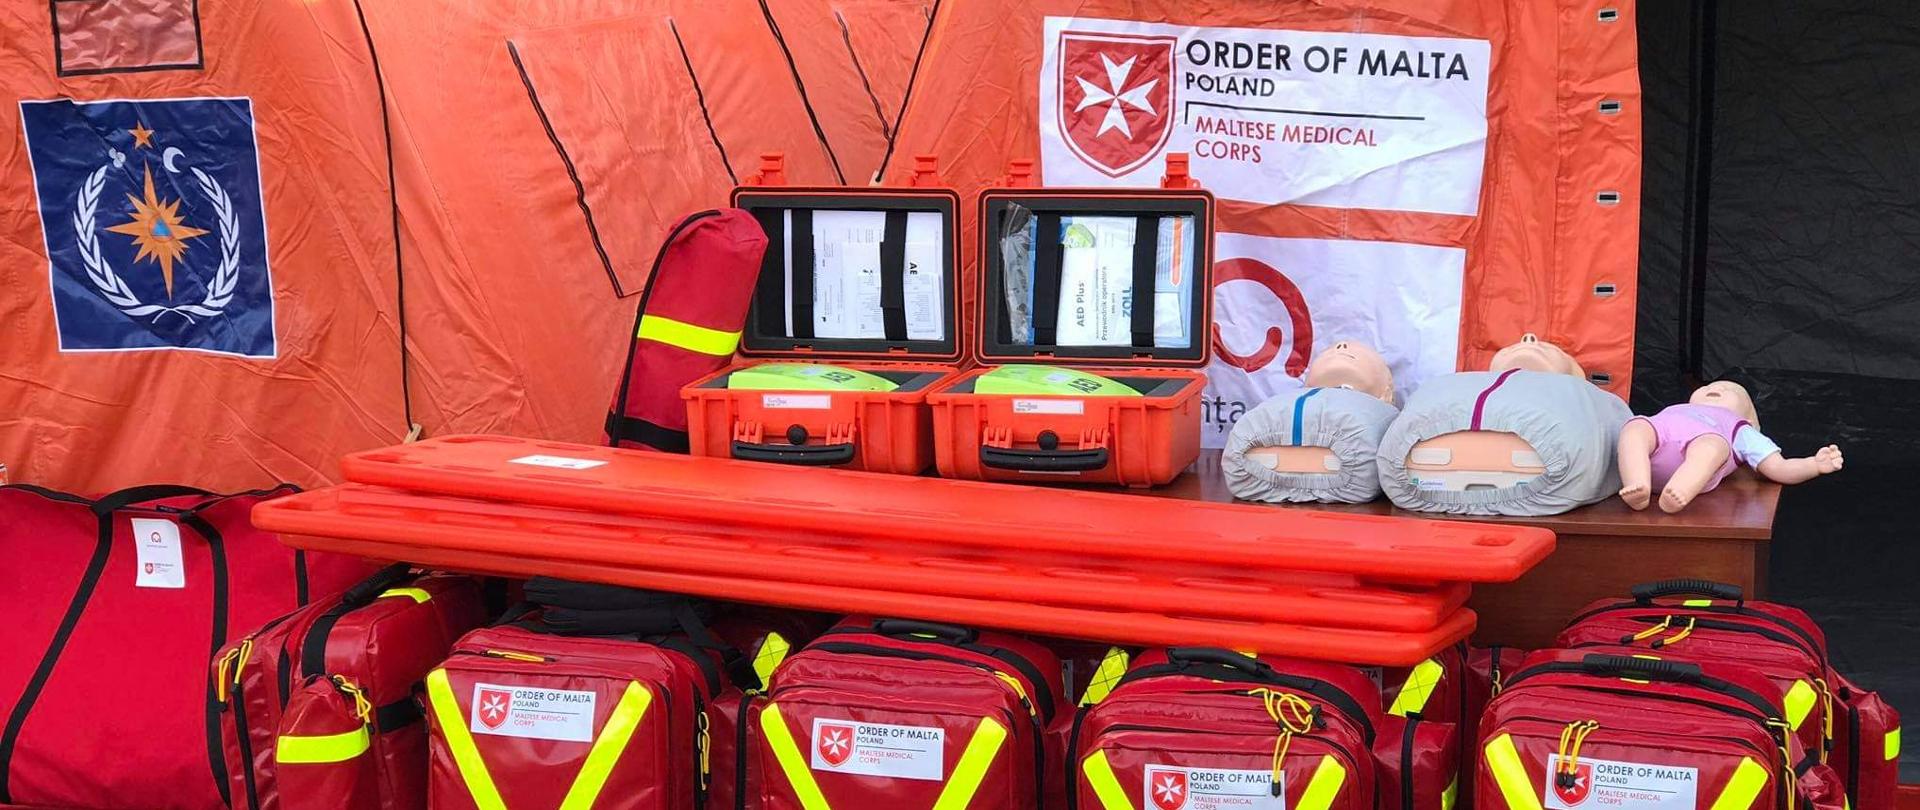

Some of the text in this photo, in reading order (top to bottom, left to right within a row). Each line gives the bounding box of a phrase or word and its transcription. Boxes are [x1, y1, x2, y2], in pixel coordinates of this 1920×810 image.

[1186, 39, 1470, 81] ORDER OF MALTA
[1186, 72, 1276, 98] POLAND
[1195, 116, 1378, 148] MALTESE MEDICAL
[1195, 141, 1262, 164] CORPS
[1076, 281, 1085, 327] AED Plus
[513, 700, 540, 708] POLAND
[515, 690, 591, 703] ORDER OF MALTA
[857, 736, 884, 745] POLAND
[858, 726, 939, 741] ORDER OF MALTA
[1190, 772, 1272, 784] ORDER OF MALT
[1595, 775, 1628, 785] POLAND
[1596, 764, 1692, 781] ORDER OF MALTA
[1190, 782, 1221, 791] POLAND
